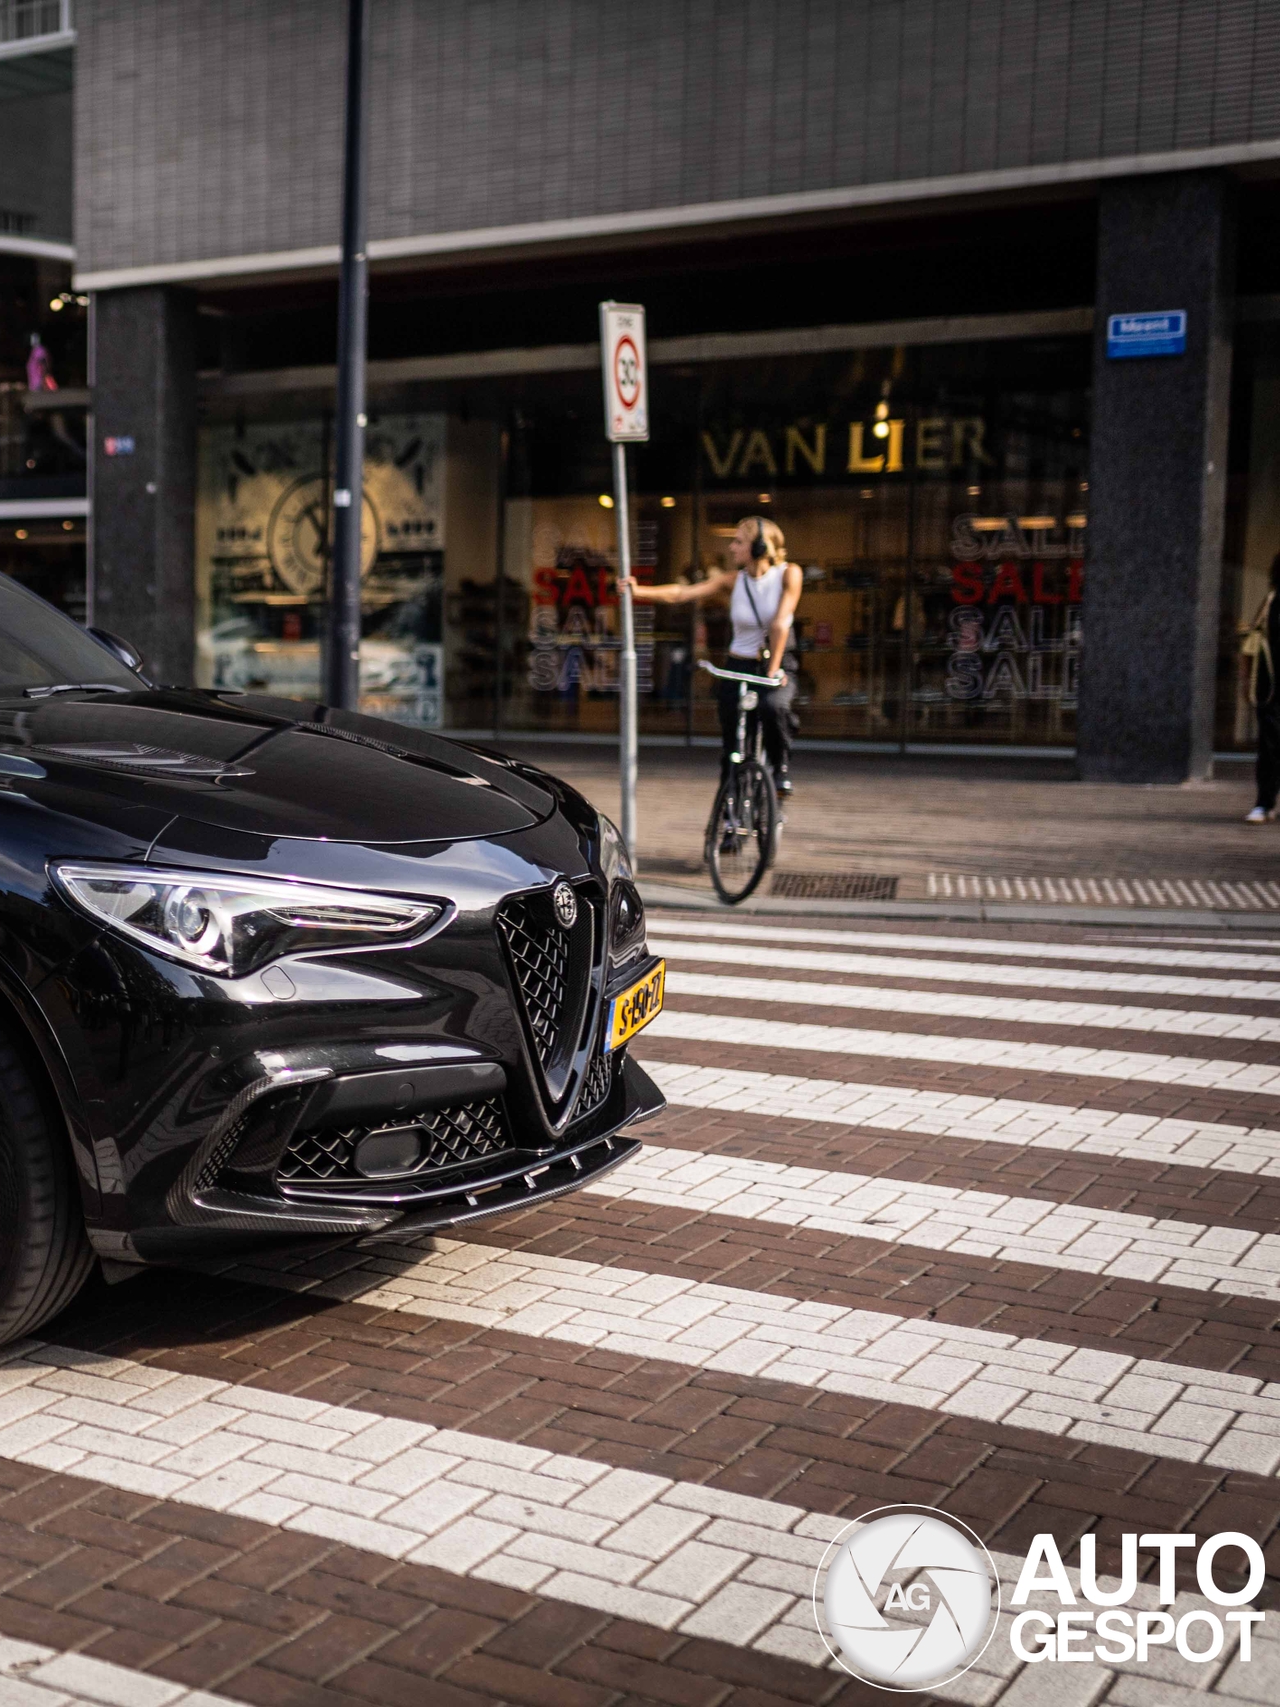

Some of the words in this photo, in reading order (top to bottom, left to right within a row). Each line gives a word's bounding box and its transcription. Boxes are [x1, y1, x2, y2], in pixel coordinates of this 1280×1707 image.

[620, 358, 638, 386] 30
[700, 422, 827, 479] VAN
[846, 418, 997, 474] LIER
